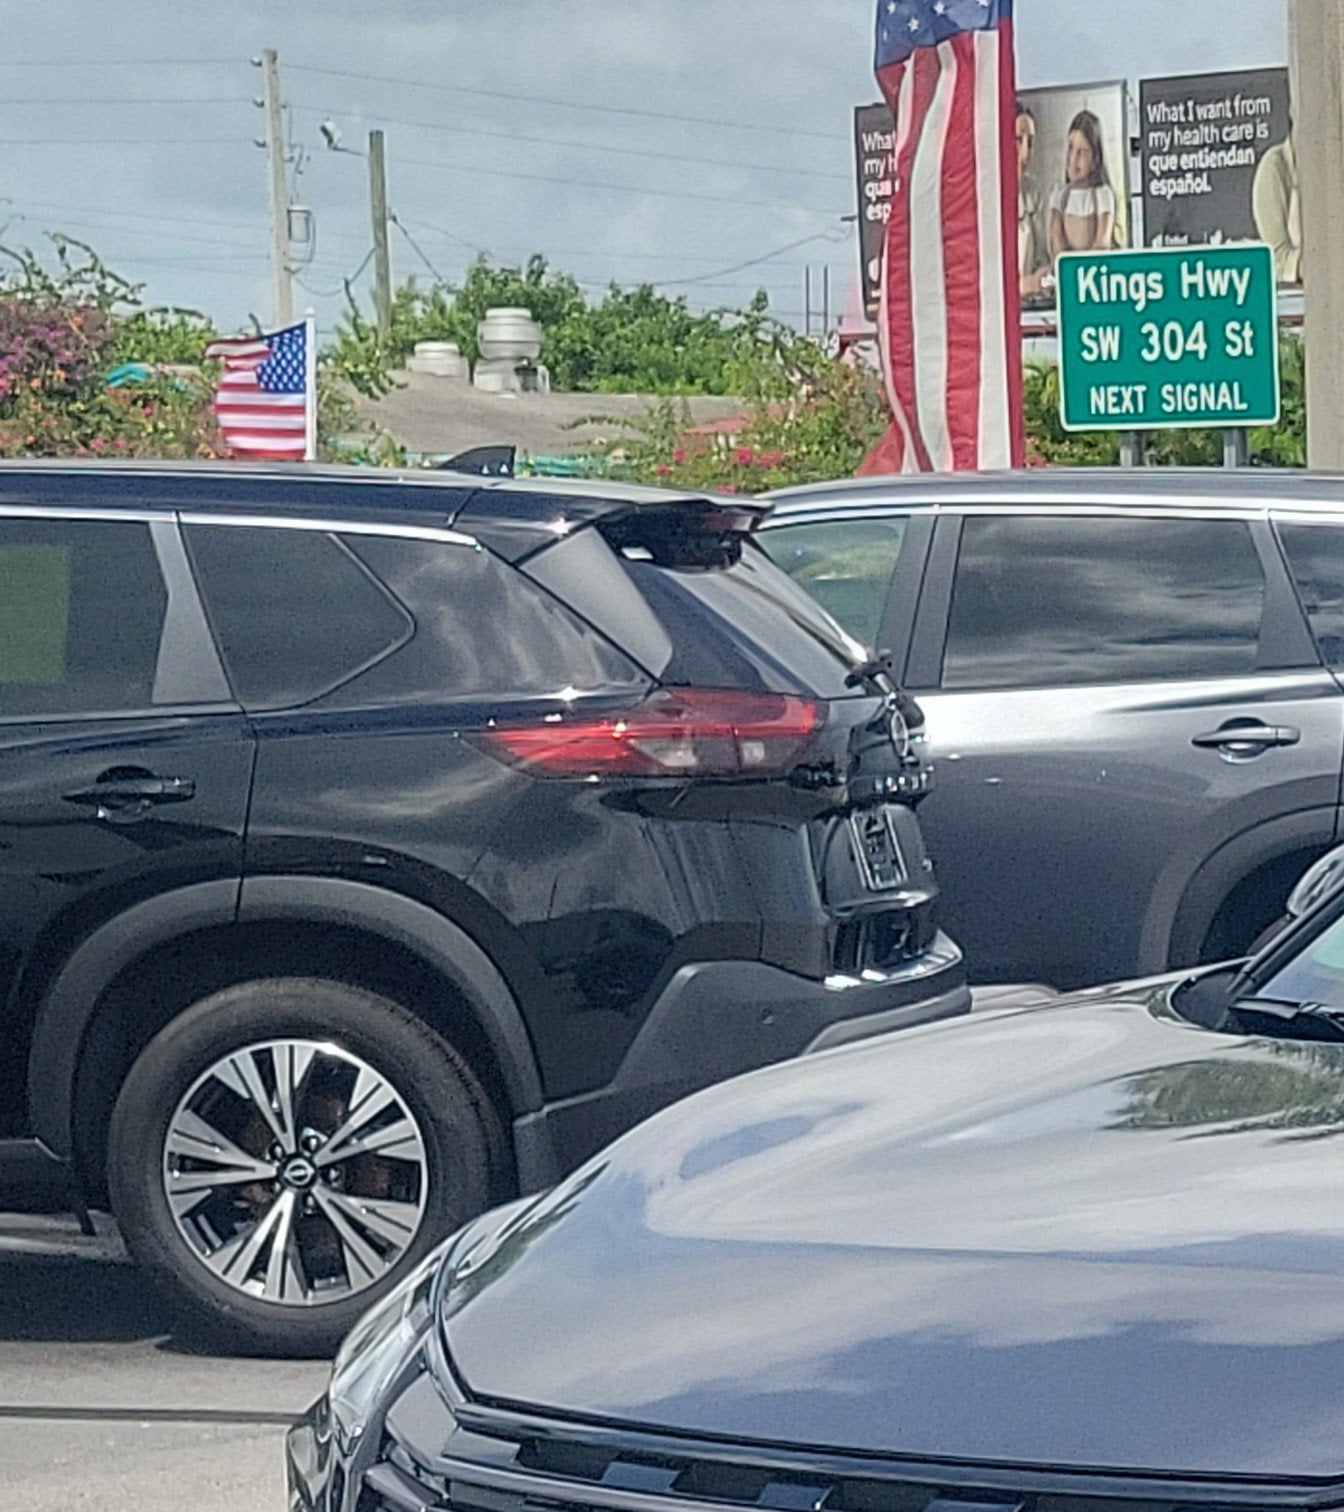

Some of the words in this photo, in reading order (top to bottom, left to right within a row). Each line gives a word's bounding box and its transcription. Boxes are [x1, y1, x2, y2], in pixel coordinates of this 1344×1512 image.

[1147, 101, 1186, 123] What
[1187, 100, 1195, 122] I
[1196, 99, 1233, 121] want
[1234, 94, 1271, 116] from
[1148, 130, 1172, 152] my
[1174, 123, 1219, 146] health
[1222, 124, 1253, 142] care
[1256, 118, 1269, 139] is
[864, 158, 886, 178] my
[1149, 154, 1178, 177] que
[1180, 145, 1255, 170] entiendan
[1077, 265, 1164, 312] Kings
[1180, 260, 1251, 306] Hwy
[1081, 325, 1120, 361] SW
[1140, 320, 1207, 361] 304
[1225, 320, 1254, 357] St
[1090, 385, 1147, 415] NEXT
[1161, 381, 1248, 412] SIGNAL
